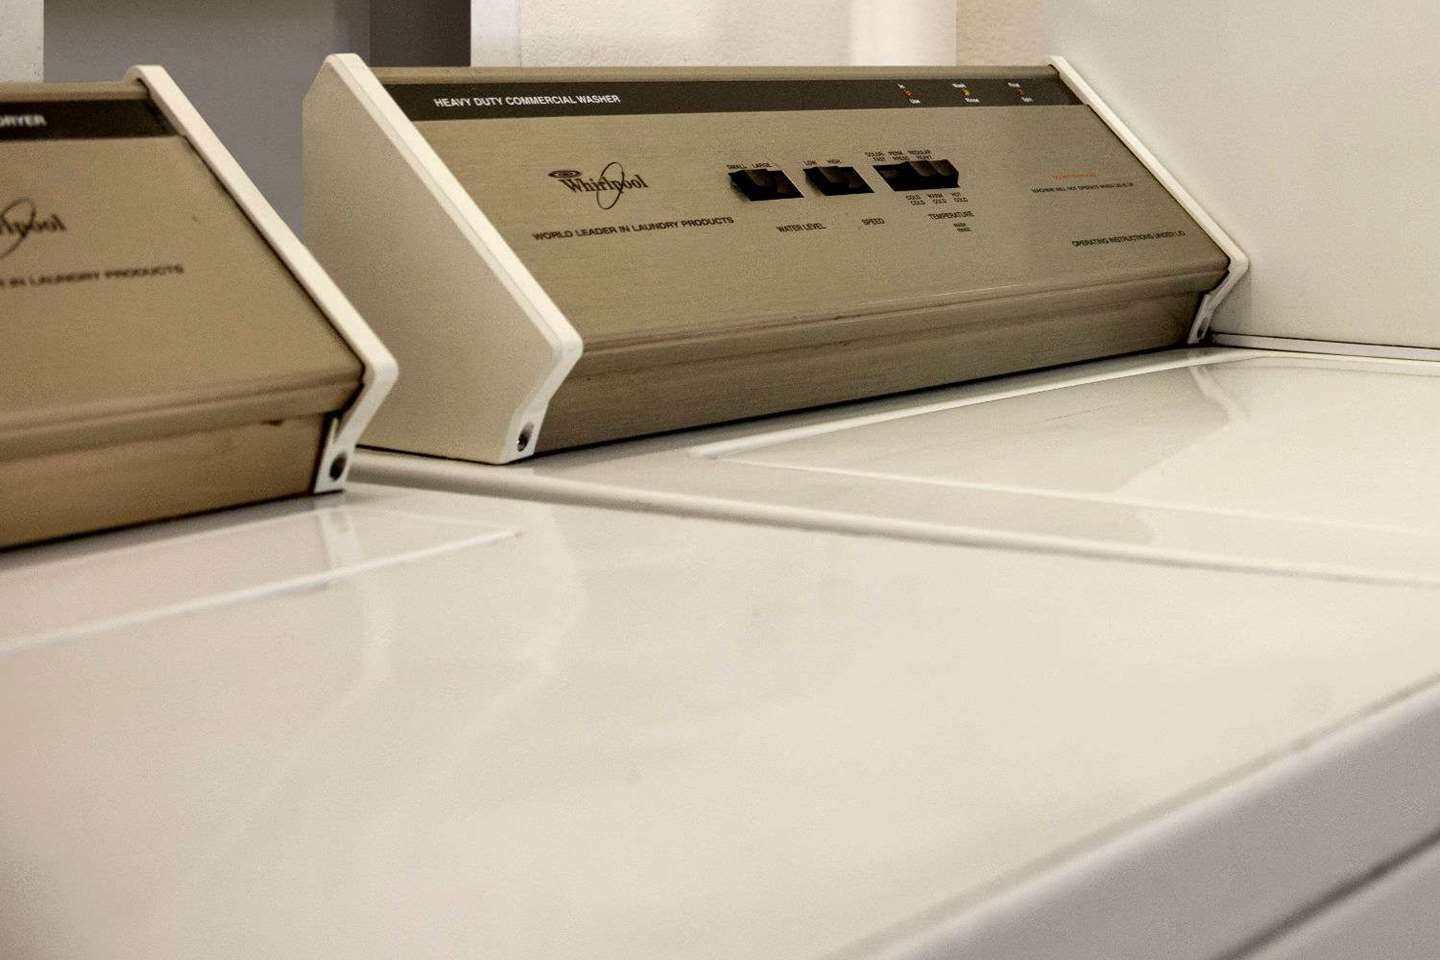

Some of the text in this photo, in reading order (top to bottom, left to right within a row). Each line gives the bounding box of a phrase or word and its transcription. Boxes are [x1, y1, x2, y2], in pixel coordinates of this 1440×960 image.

[433, 94, 622, 107] HEAVY DUTY COMMERCIAL WASHER
[557, 173, 649, 194] Whirlpool
[928, 210, 976, 220] TEMPERATURE
[776, 222, 827, 233] WATER LEVEL
[861, 217, 886, 226] SPEED
[532, 216, 735, 241] WORLD LEADER IN LAUNDRY PRODUCTS
